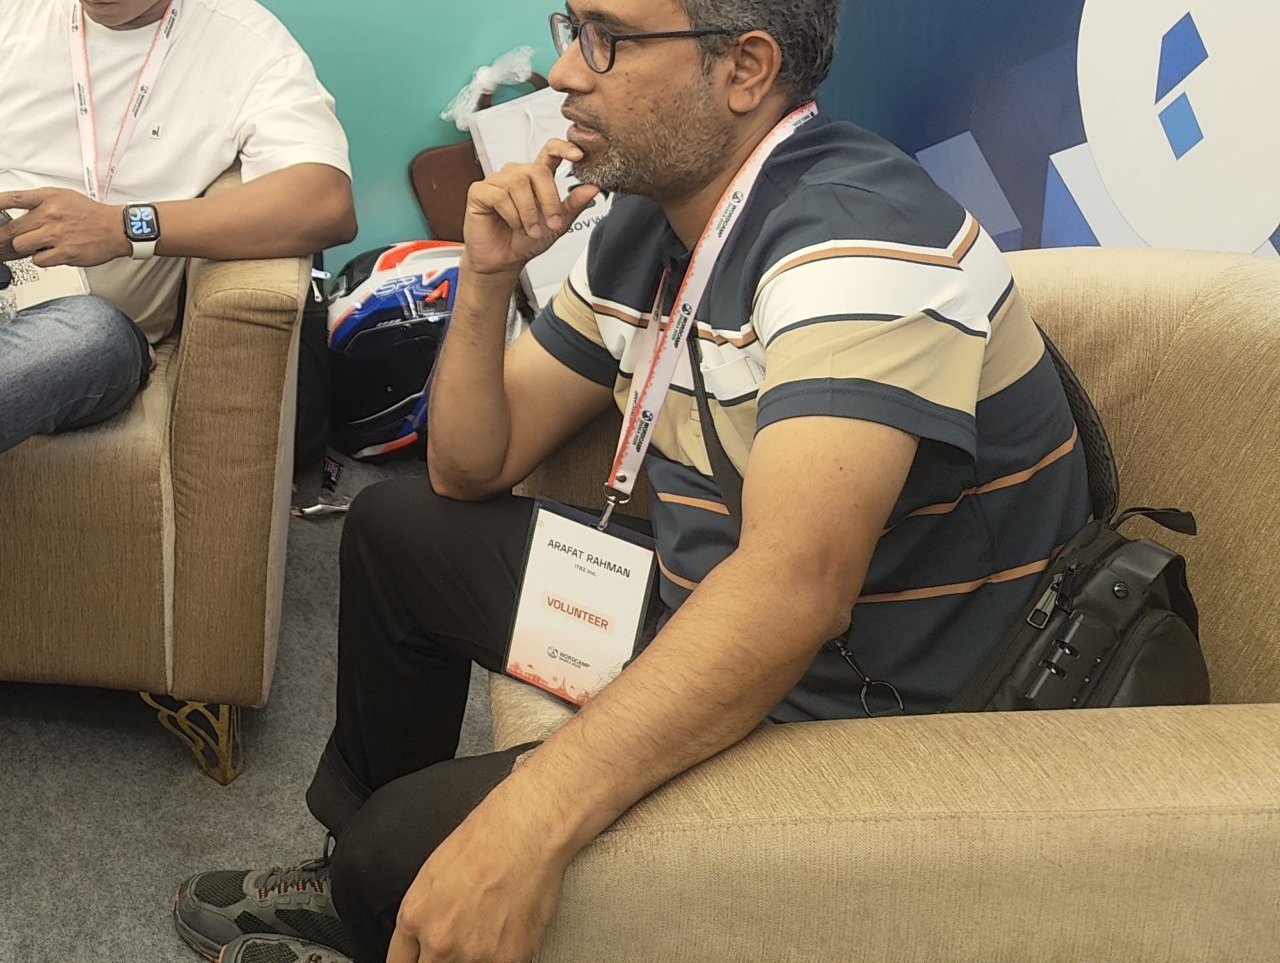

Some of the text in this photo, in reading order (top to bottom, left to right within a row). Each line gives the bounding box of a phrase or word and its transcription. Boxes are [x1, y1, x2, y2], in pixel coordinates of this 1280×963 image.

[547, 538, 631, 579] ARAFAT RAHMAN
[547, 595, 609, 630] VOLUNTEER
